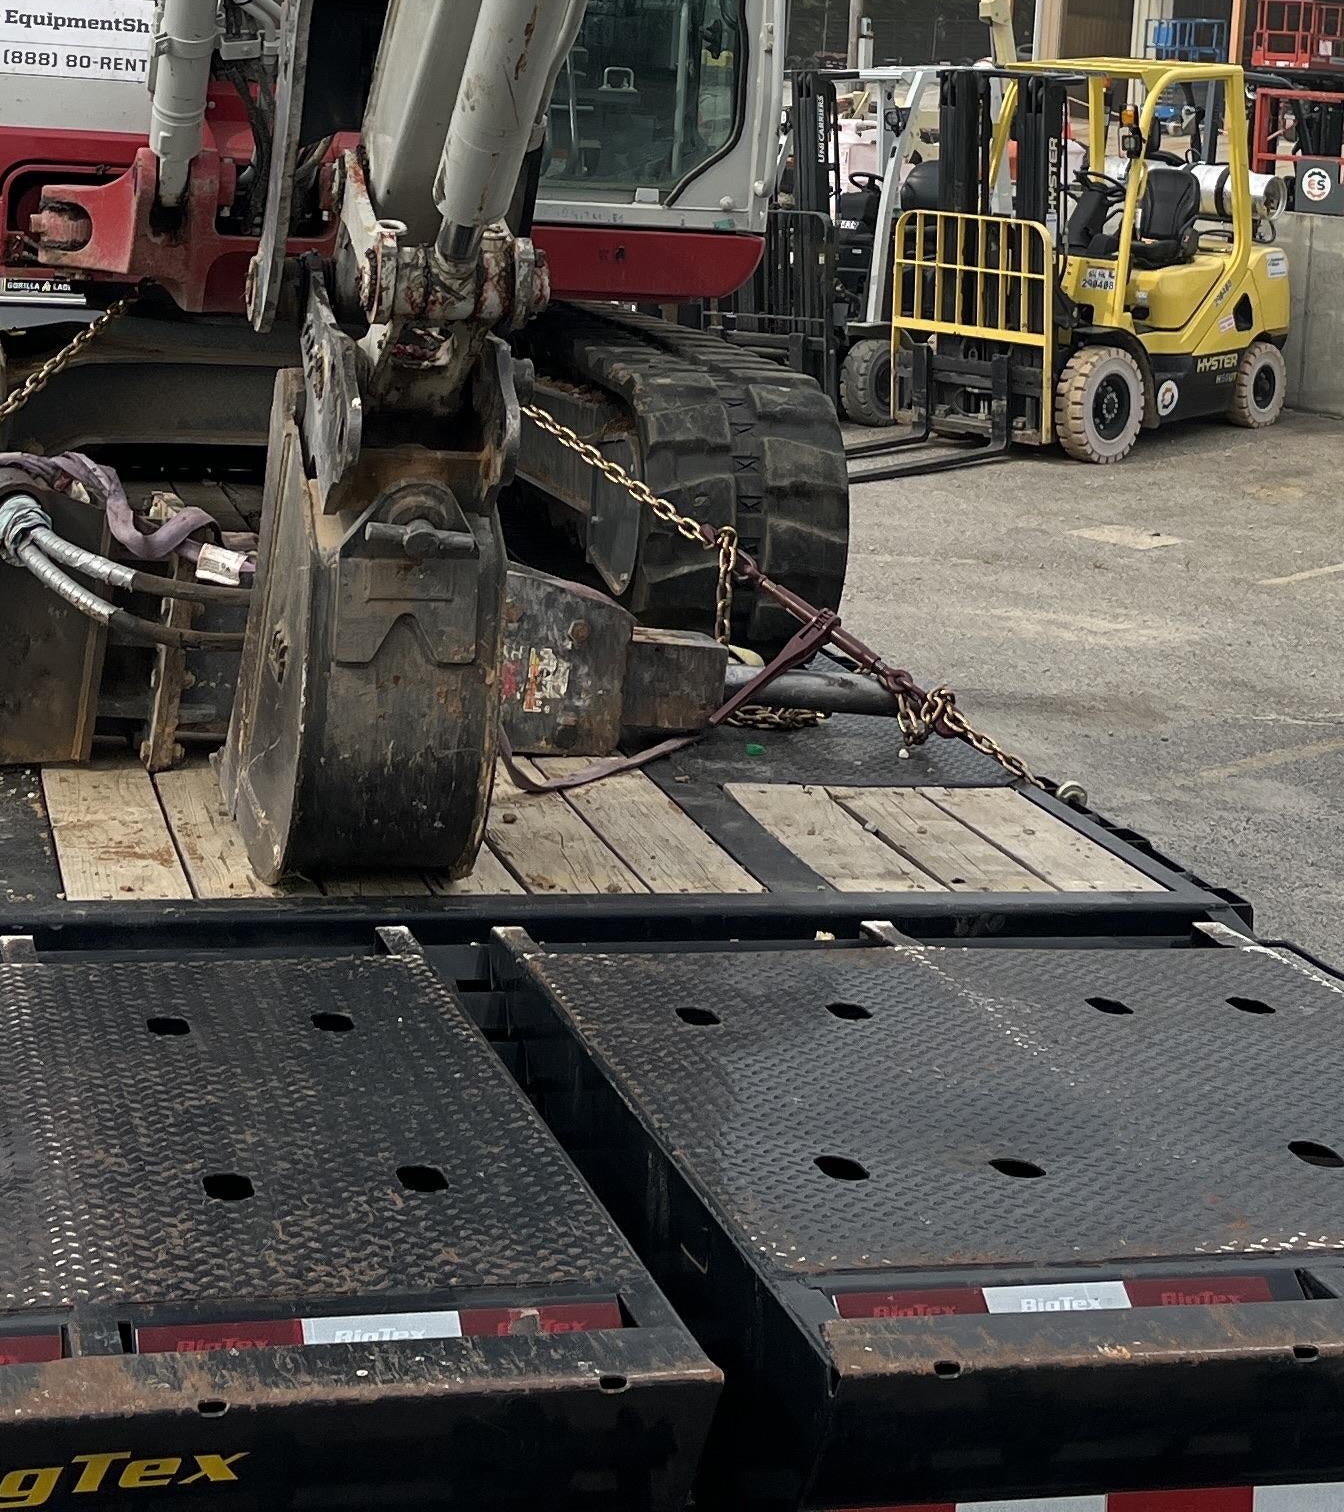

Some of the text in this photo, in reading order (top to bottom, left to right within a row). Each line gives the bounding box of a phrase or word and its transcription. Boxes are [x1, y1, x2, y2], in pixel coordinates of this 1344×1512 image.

[5, 9, 150, 34] EquipmentSh
[3, 49, 57, 68] (888)
[1047, 137, 1058, 214] HYSTER
[1196, 353, 1239, 373] HYSTER
